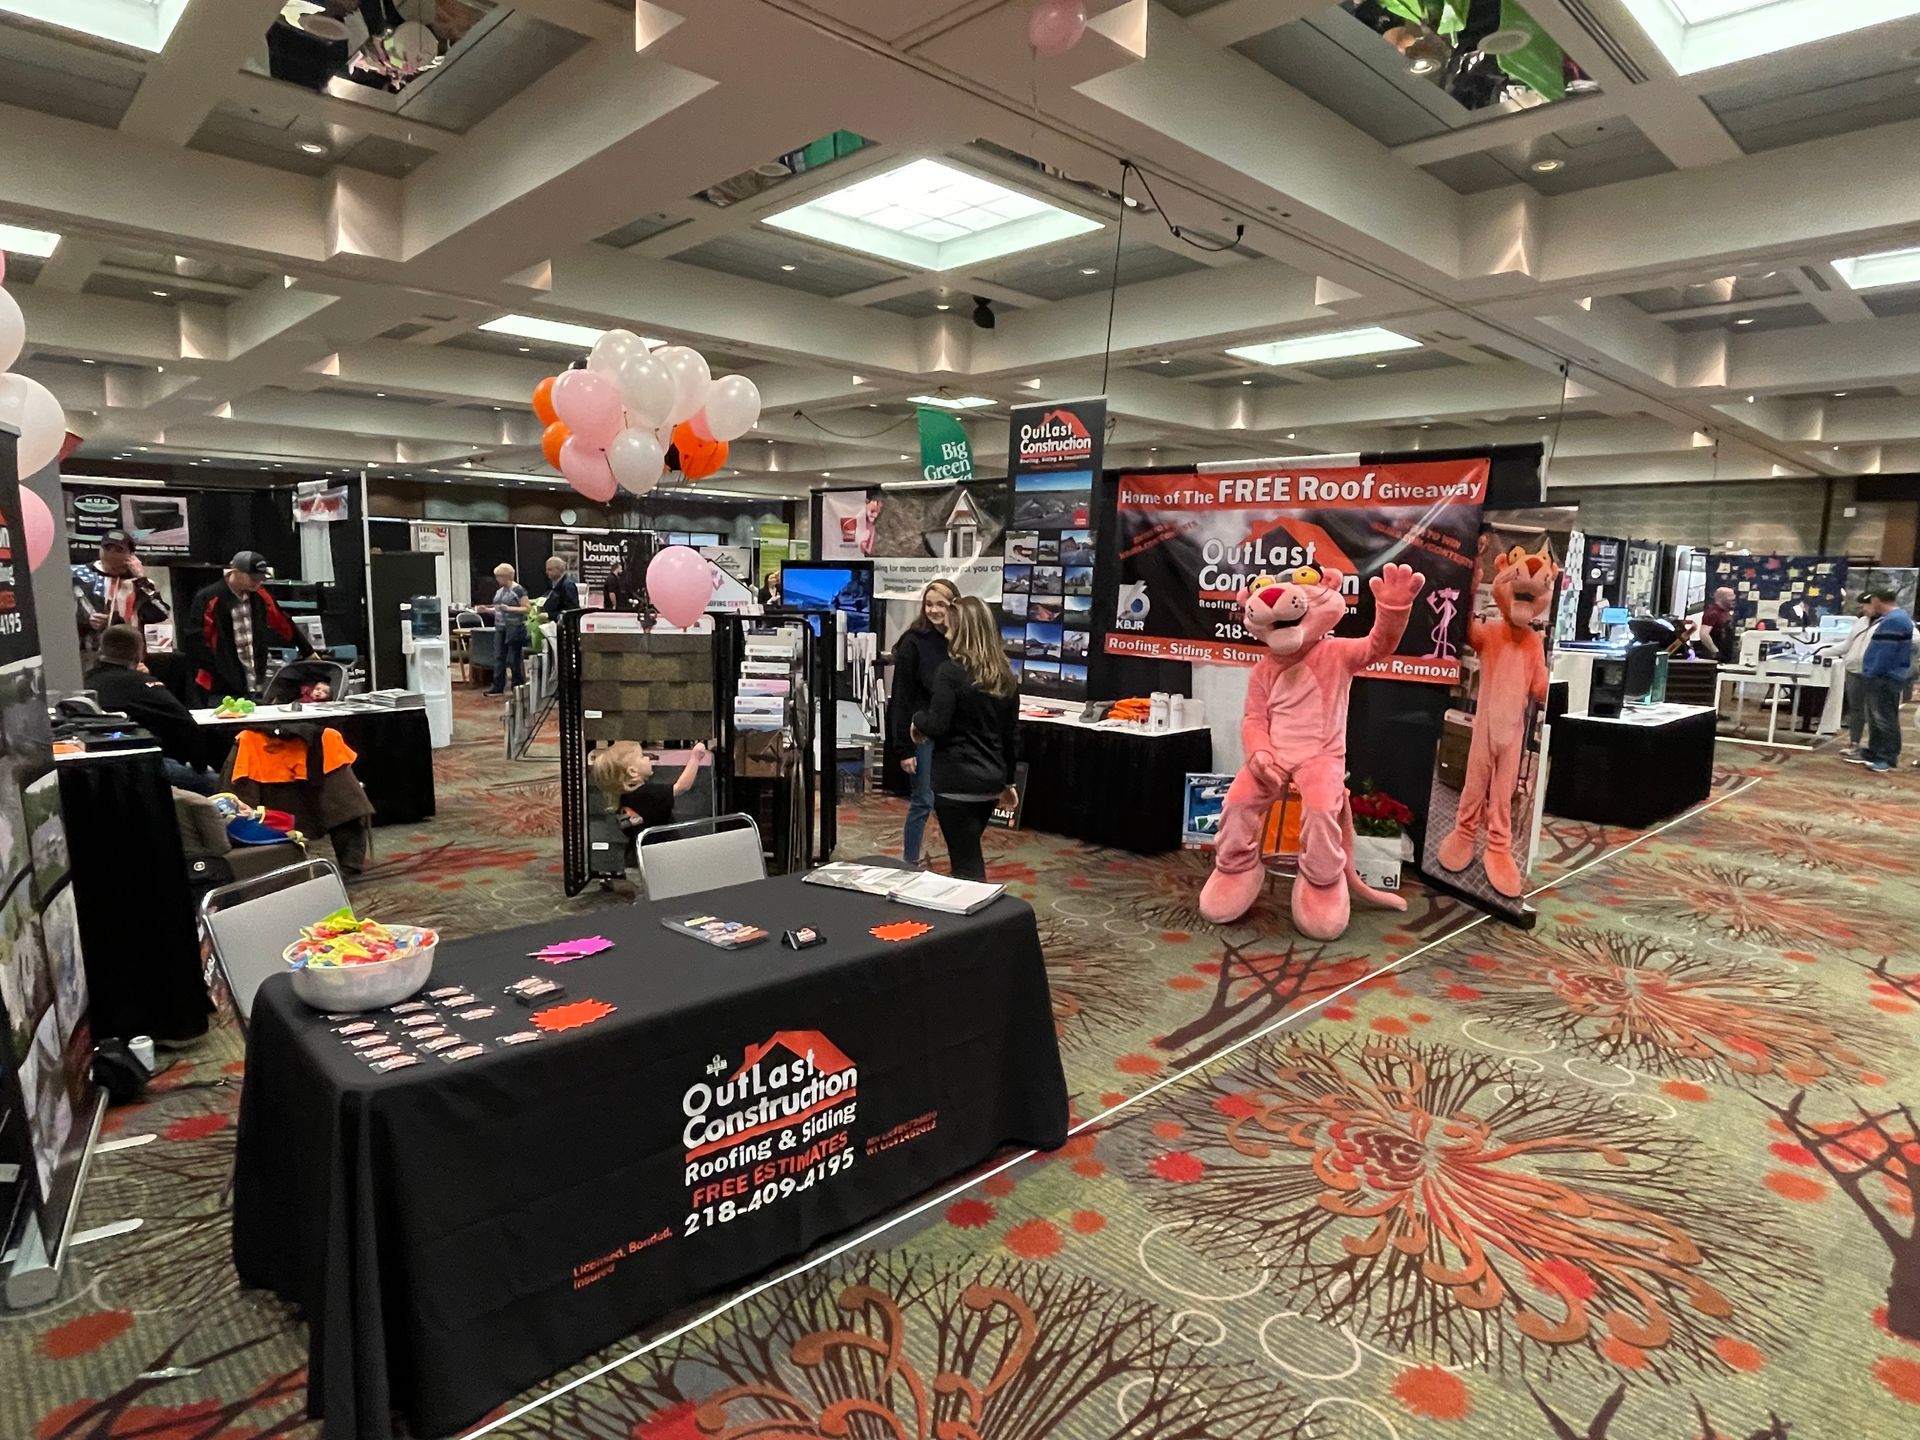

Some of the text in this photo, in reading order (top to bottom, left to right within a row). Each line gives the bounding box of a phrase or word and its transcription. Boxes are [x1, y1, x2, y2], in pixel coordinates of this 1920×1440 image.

[1020, 422, 1073, 440] OutLast
[941, 441, 968, 461] Big
[1020, 435, 1092, 454] Construction
[923, 459, 971, 481] Green
[1121, 472, 1482, 505] Home of The FREE Roof Giveaway
[1202, 538, 1317, 566] OutLast
[973, 565, 988, 574] you
[1115, 619, 1145, 631] KBJR
[1108, 637, 1160, 655] Roofing
[1169, 643, 1213, 660] Siding
[1391, 660, 1460, 679] Removal
[992, 808, 1015, 819] TLAST
[682, 1048, 815, 1118] OutLast
[682, 1067, 858, 1149] Construction
[685, 1137, 772, 1187] Roofing
[778, 1129, 797, 1150] &
[802, 1102, 857, 1143] Siding
[692, 1131, 849, 1208] FREE ESTIMATES
[683, 1147, 855, 1237] 218-409-4195
[573, 1226, 673, 1277] Licensed, Bonded,
